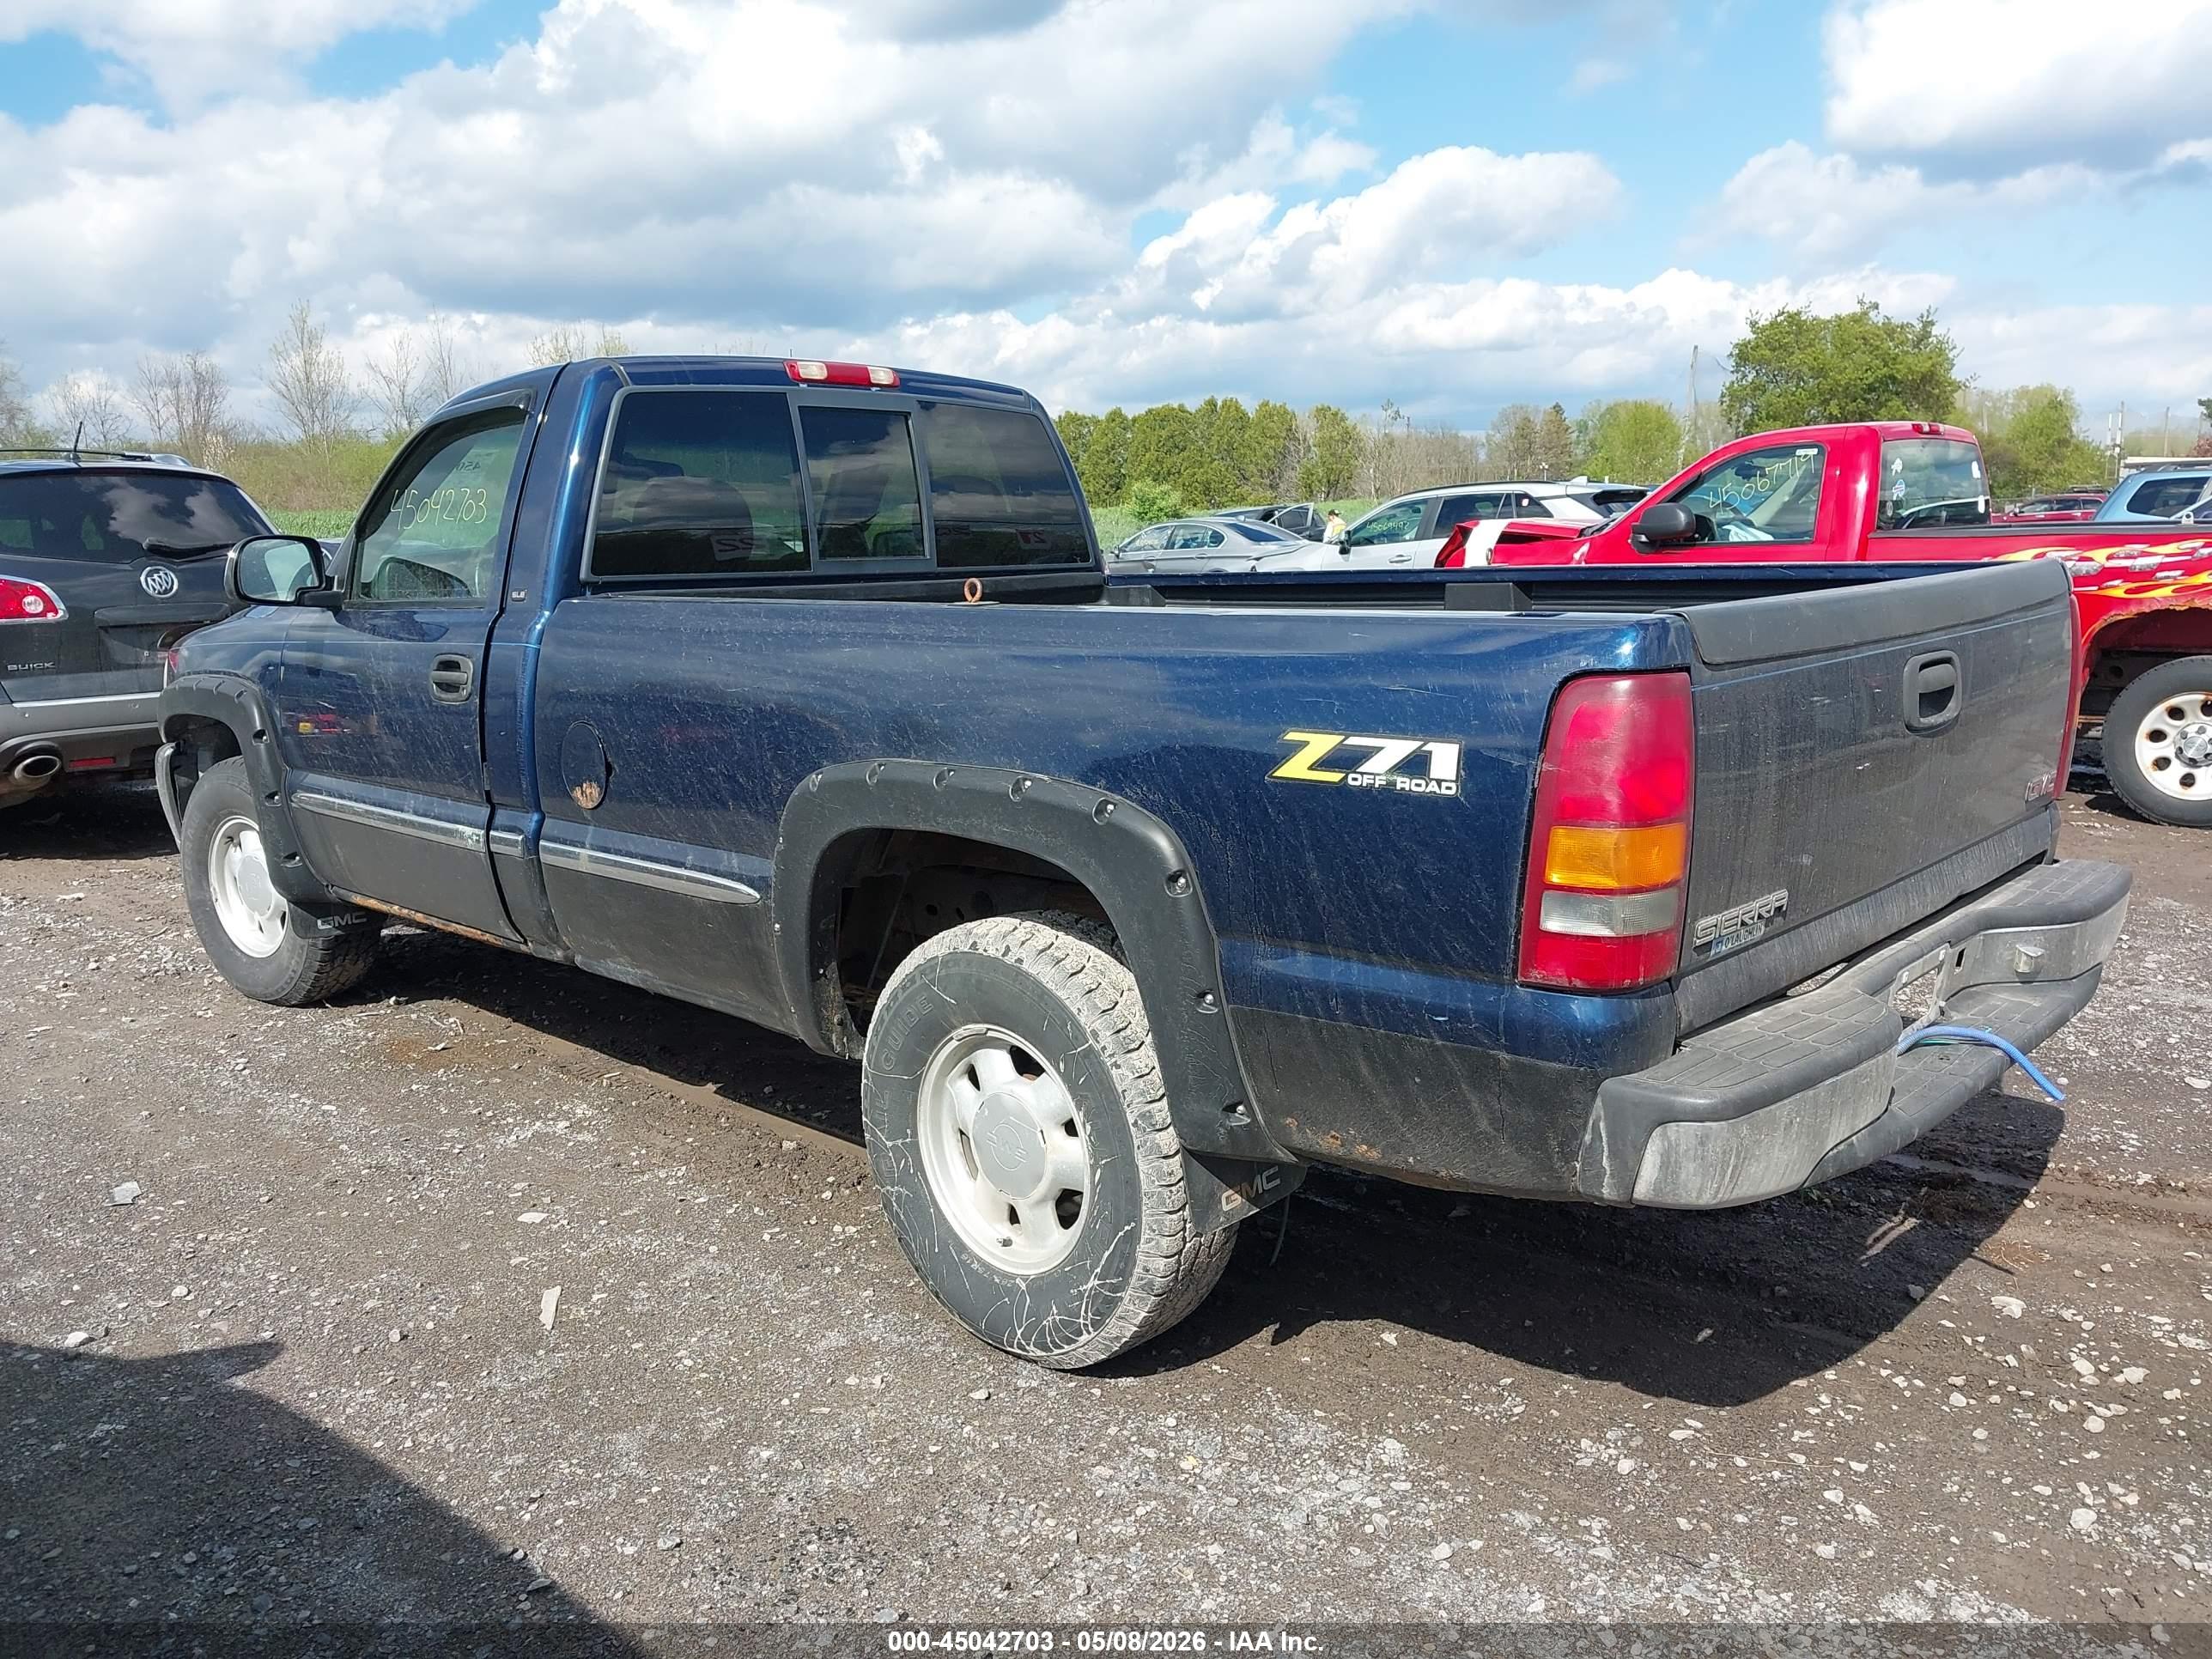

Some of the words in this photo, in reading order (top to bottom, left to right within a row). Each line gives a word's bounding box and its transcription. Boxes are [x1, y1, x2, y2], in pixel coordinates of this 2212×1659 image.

[1709, 453, 1814, 515] 45067719
[390, 488, 488, 531] 45042703
[7, 662, 56, 671] BUICK
[1271, 731, 1462, 783] Z71
[1346, 773, 1388, 788] OFF
[1395, 777, 1457, 796] ROAD
[317, 911, 368, 930] GMC
[1693, 889, 1789, 947] SIERRA
[882, 994, 934, 1071] GUIDE
[1221, 1165, 1281, 1212] GMC
